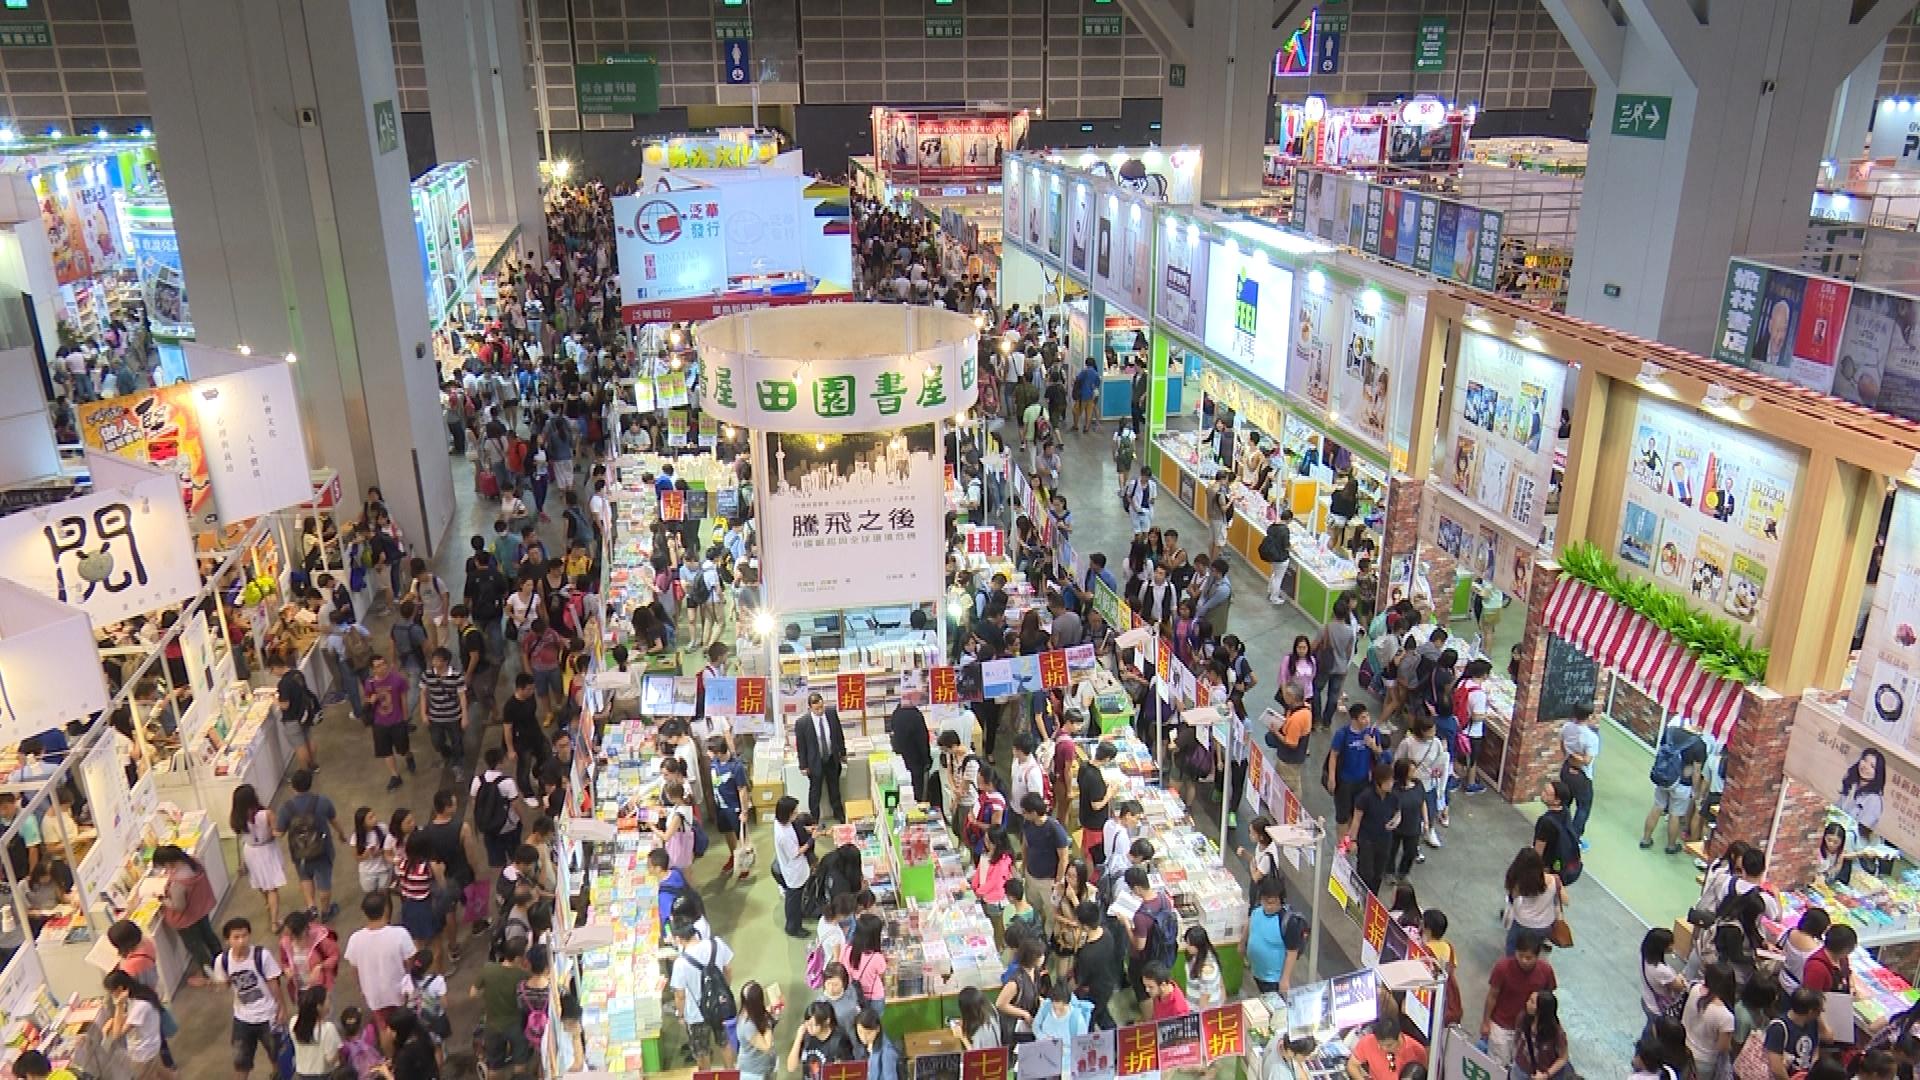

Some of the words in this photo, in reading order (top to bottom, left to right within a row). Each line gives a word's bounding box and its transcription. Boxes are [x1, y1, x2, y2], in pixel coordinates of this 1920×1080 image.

[690, 220, 721, 239] 發行
[756, 363, 947, 418] 田園書屋
[792, 508, 916, 537] 騰飛之後
[935, 669, 956, 702] 七折
[1043, 653, 1065, 687] 七折
[740, 679, 764, 713] 七折
[841, 676, 864, 710] 七折
[1369, 903, 1387, 955] 七折
[1207, 1010, 1240, 1058] 七折
[1125, 1029, 1156, 1074] 七折
